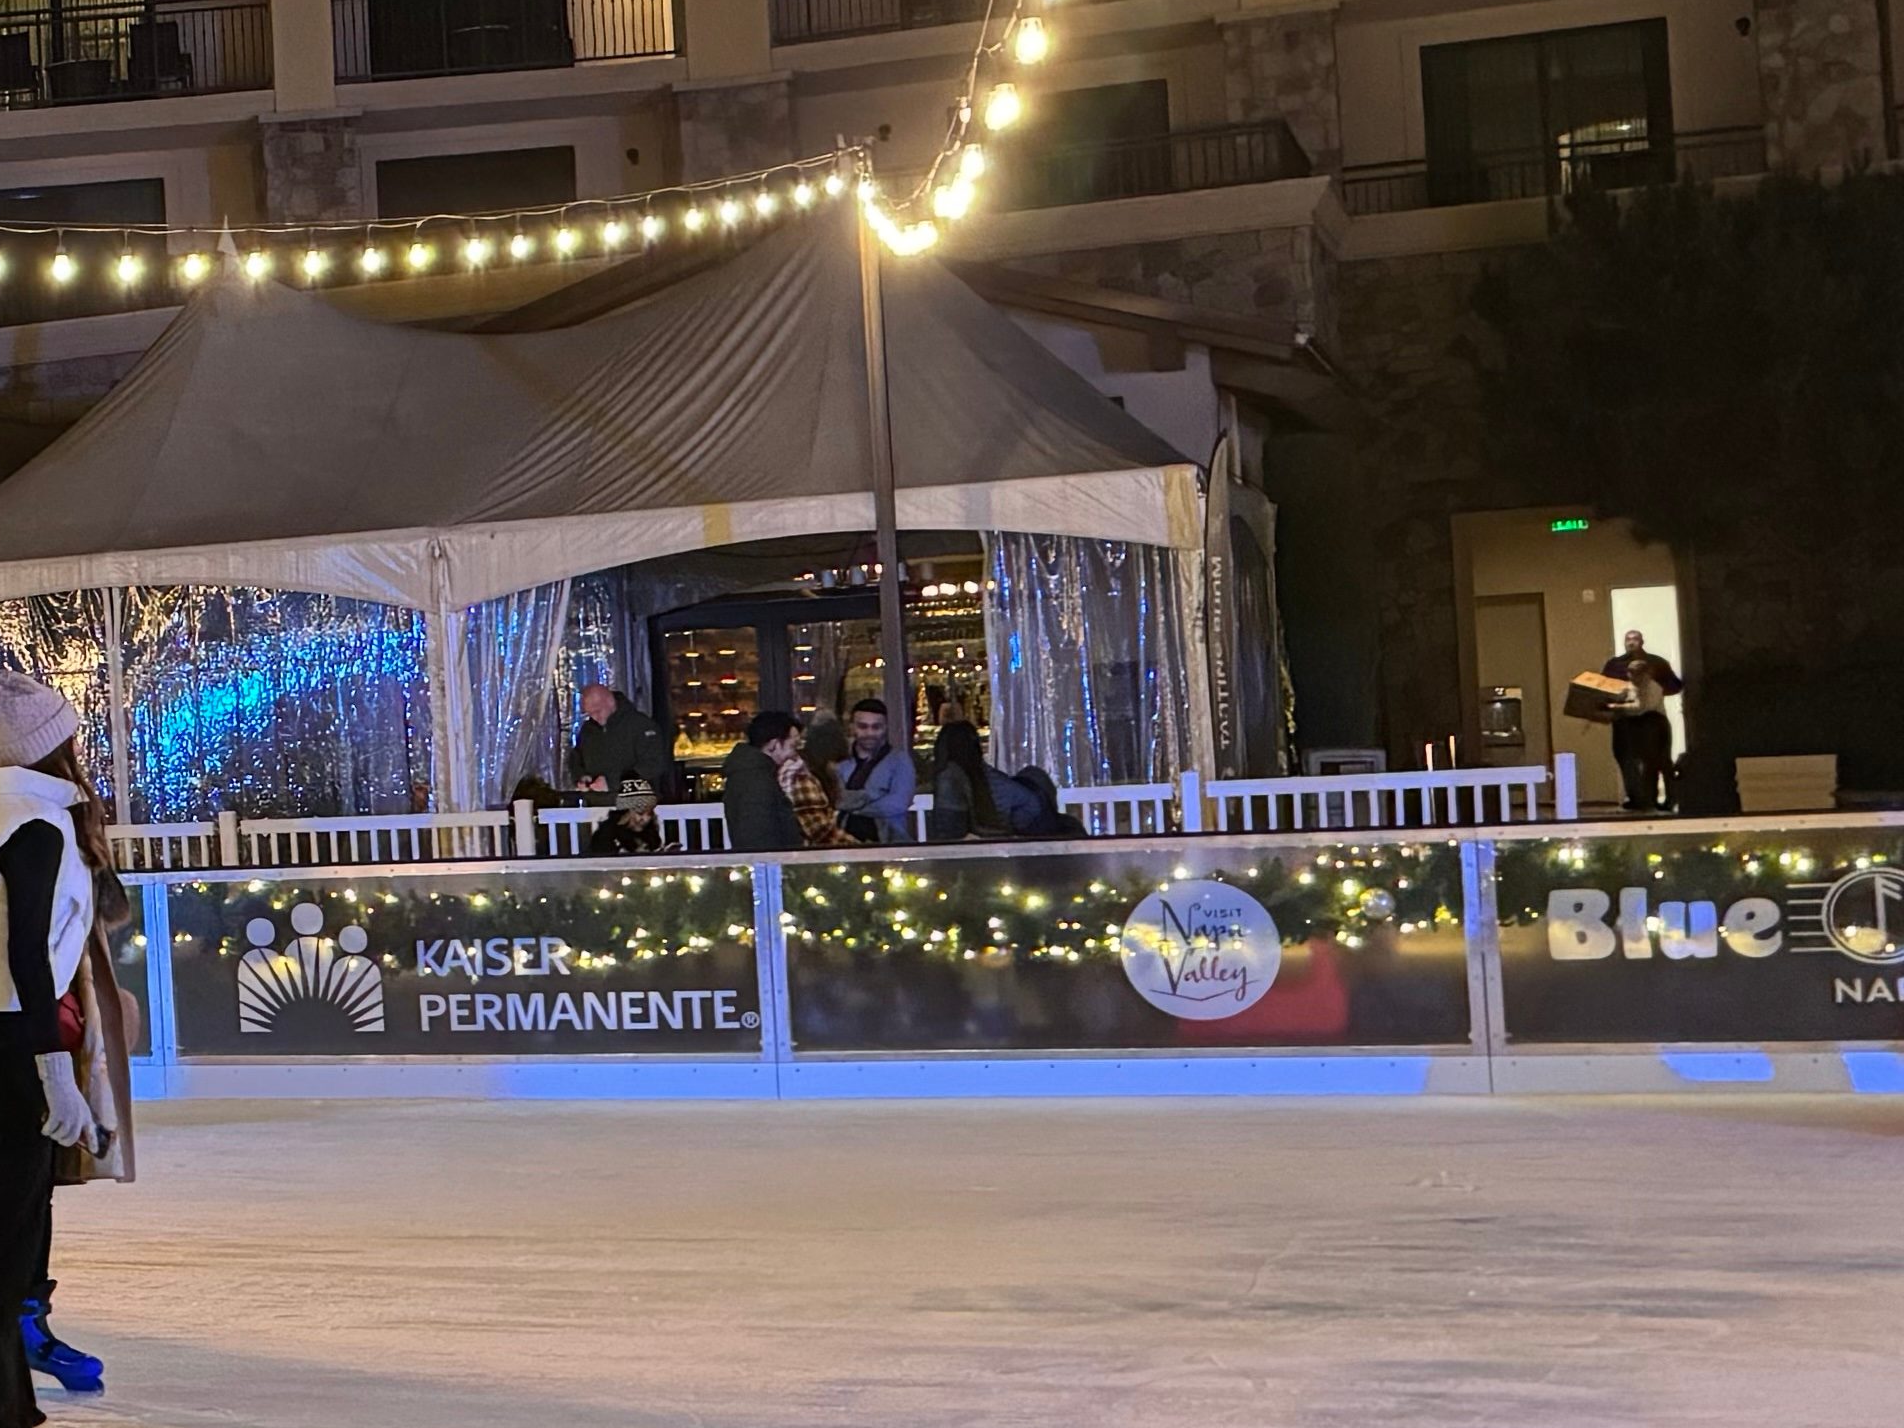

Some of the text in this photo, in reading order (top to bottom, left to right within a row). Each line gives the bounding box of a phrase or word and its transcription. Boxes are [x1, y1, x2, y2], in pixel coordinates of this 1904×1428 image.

[1159, 898, 1247, 951] Napa
[1203, 907, 1242, 919] VISIT
[1547, 886, 1784, 961] Blue
[415, 936, 572, 977] KAISER
[1158, 944, 1261, 1002] Valley
[1834, 976, 1904, 1004] NA
